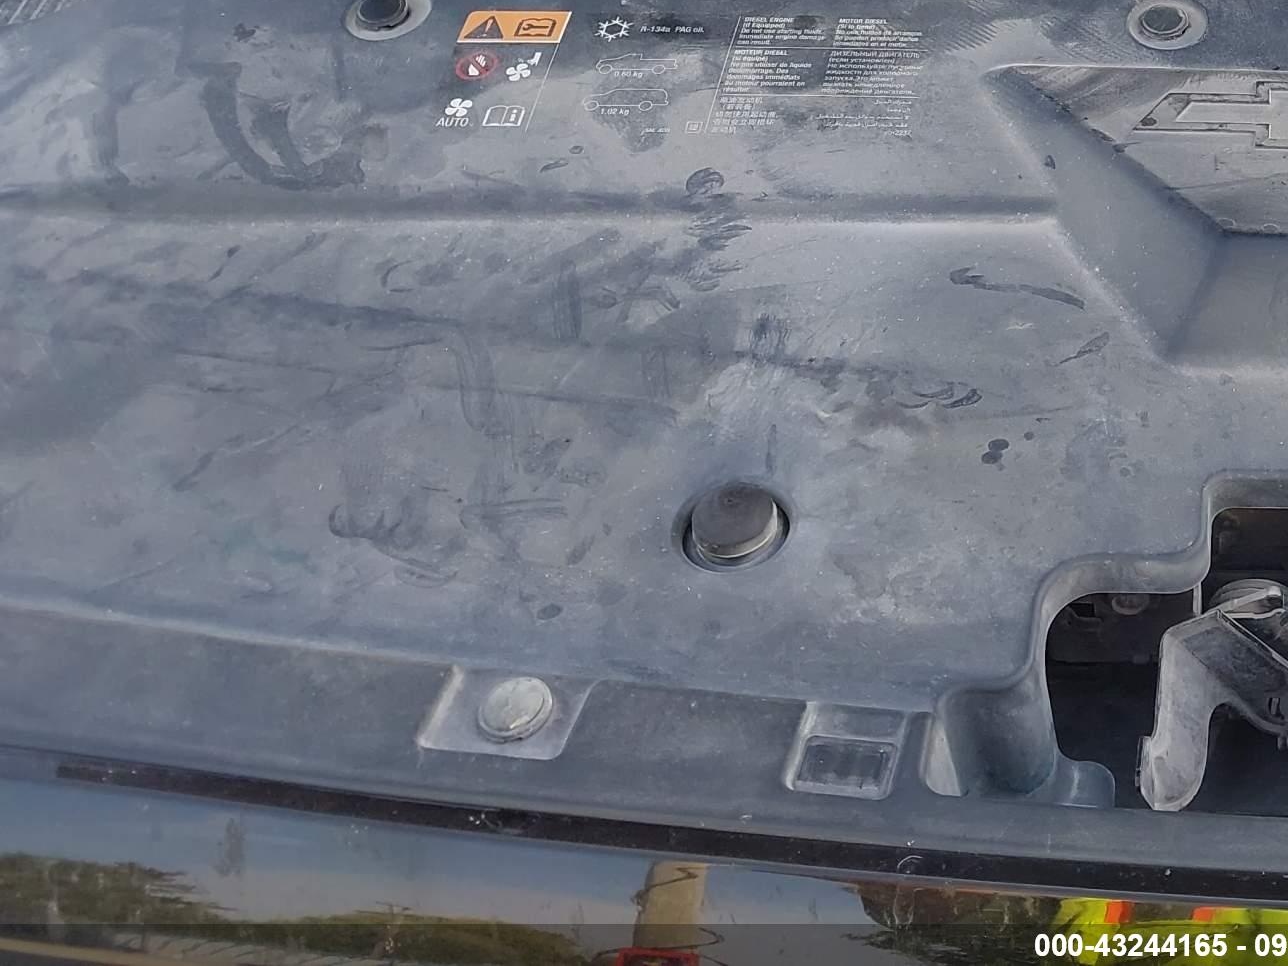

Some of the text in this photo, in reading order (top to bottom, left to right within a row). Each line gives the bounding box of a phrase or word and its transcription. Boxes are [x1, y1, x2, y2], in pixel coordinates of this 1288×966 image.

[640, 25, 671, 33] R-134a
[674, 25, 692, 33] PAG
[436, 117, 469, 127] AUTO
